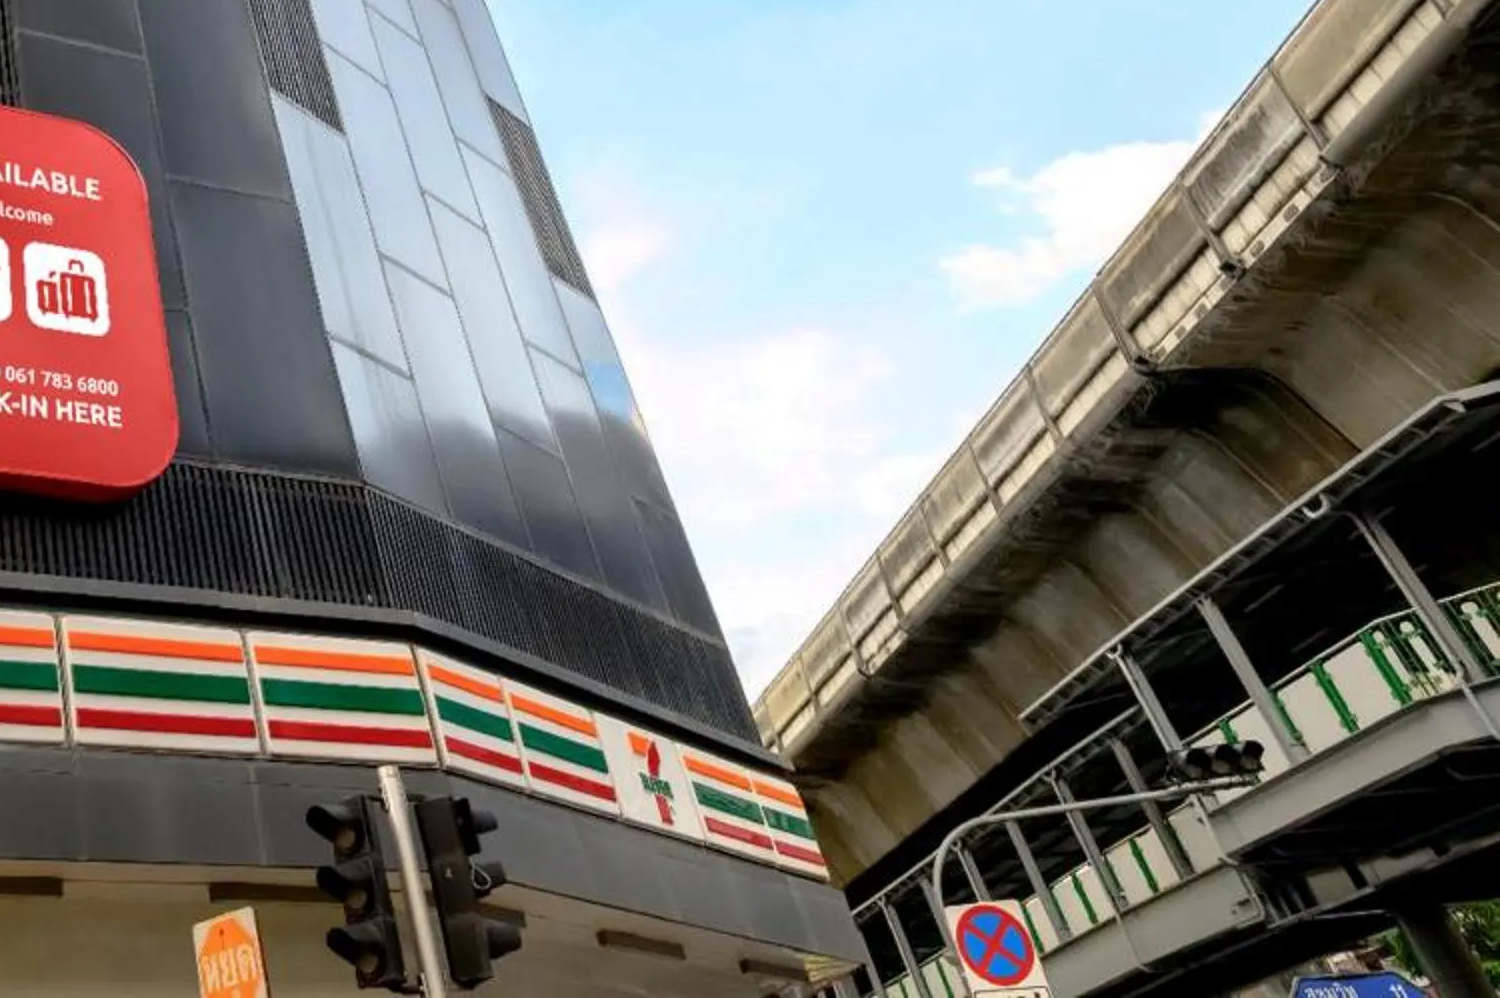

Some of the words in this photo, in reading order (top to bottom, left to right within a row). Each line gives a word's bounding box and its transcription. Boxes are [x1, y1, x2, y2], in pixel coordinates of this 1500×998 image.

[4, 365, 35, 384] 061
[42, 371, 73, 390] 783
[76, 377, 119, 397] 6800
[55, 399, 123, 428] HERE
